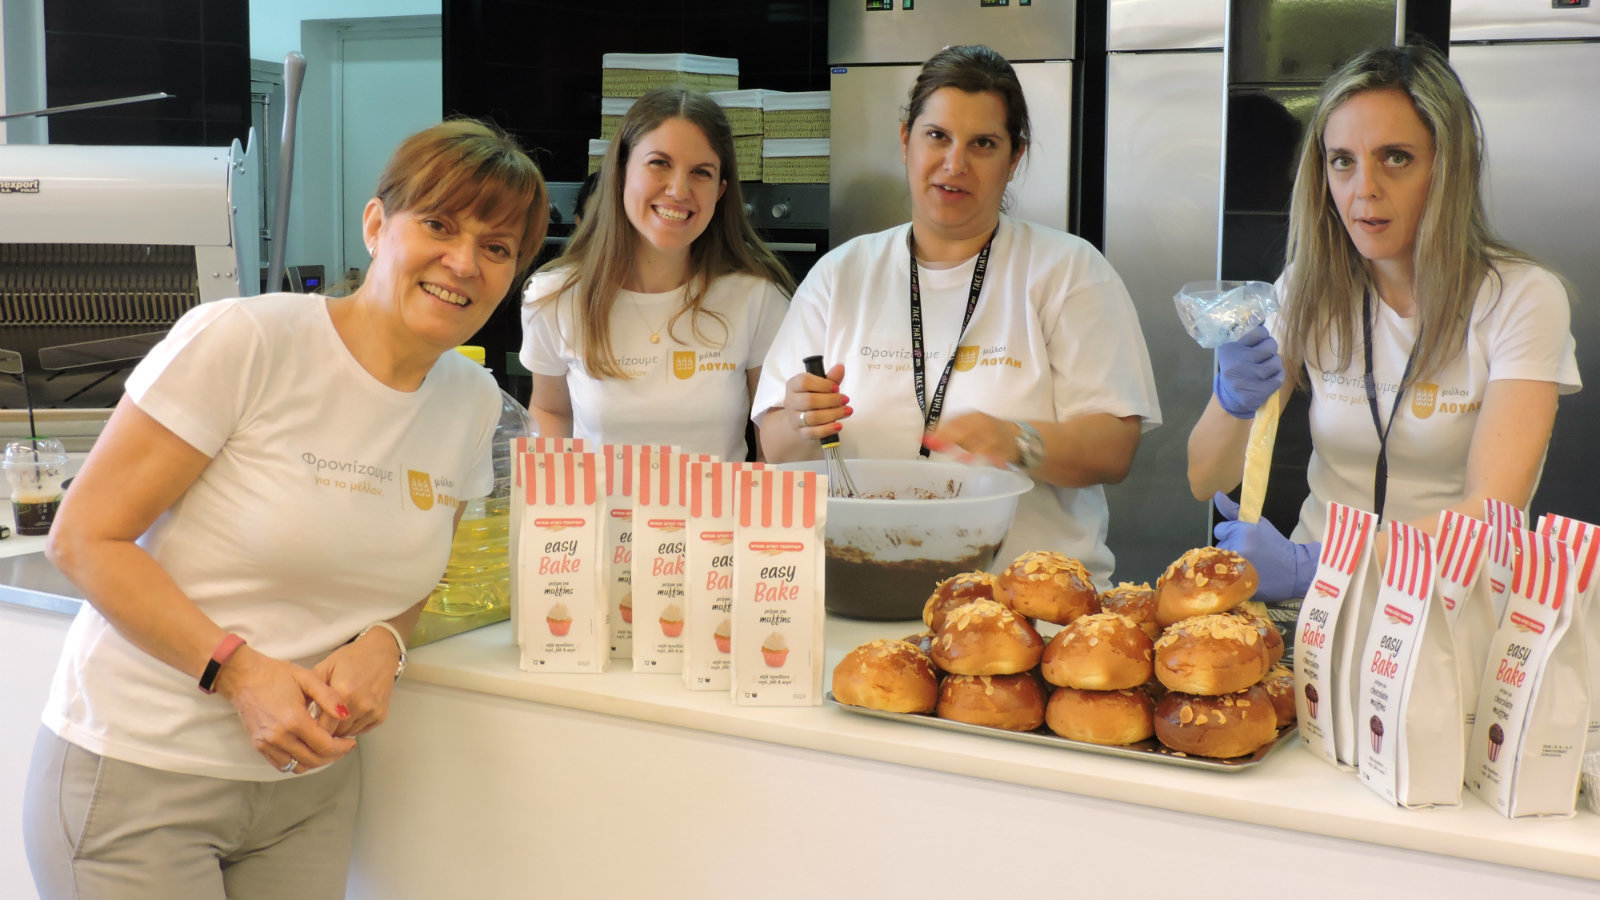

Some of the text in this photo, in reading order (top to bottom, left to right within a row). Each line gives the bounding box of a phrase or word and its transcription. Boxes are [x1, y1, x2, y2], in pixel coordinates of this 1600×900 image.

[976, 256, 988, 273] THAT
[972, 274, 984, 291] TAKE
[912, 306, 920, 322] TAKE
[913, 324, 922, 340] THAT
[915, 371, 924, 389] TAKE
[1442, 387, 1469, 398] μύλοι
[932, 393, 945, 413] THAT
[302, 452, 393, 483] Φροντίζουμε
[544, 540, 578, 556] easy
[539, 553, 581, 576] Bake
[652, 555, 685, 576] Bak
[712, 555, 733, 568] eas
[760, 565, 796, 582] easy
[544, 586, 573, 597] muffins
[657, 588, 684, 598] muffin
[753, 579, 799, 603] Bake
[759, 614, 791, 626] muffins
[1309, 608, 1329, 629] easy
[1302, 622, 1326, 649] Bake
[1380, 634, 1403, 658] easy
[1507, 643, 1531, 667] easy
[1371, 650, 1398, 679] Bake
[1496, 658, 1526, 688] Bake
